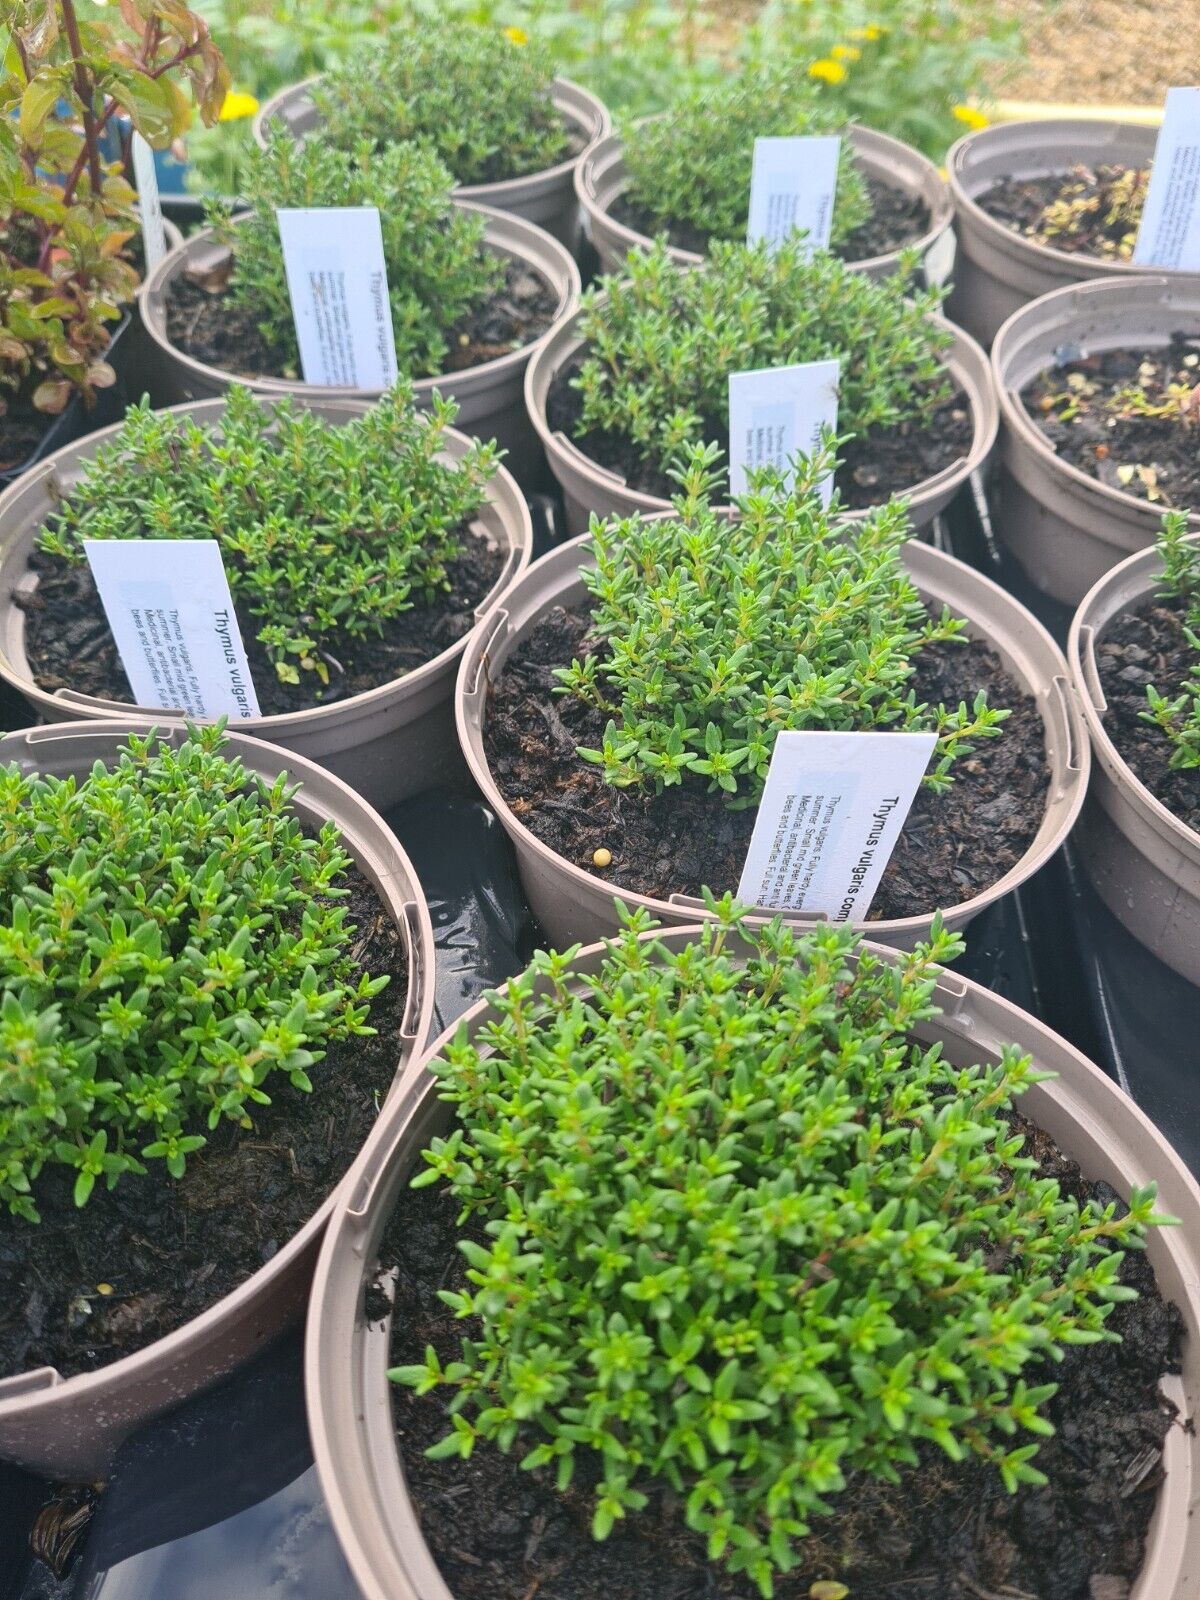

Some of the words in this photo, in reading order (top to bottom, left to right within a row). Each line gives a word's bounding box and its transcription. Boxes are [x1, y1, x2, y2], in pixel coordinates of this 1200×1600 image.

[131, 609, 145, 629] bees
[138, 631, 150, 646] and
[158, 688, 169, 701] Full
[167, 646, 182, 666] Small
[168, 609, 185, 641] Thymus
[188, 676, 200, 693] Fully
[195, 695, 208, 714] hardy
[214, 609, 237, 665] Thymus
[230, 669, 254, 718] vulgaris
[156, 651, 177, 696] antibacterial
[175, 668, 186, 682] mid
[179, 684, 192, 704] green
[783, 795, 798, 813] bees
[822, 796, 842, 824] Thymus
[779, 815, 791, 829] and
[866, 796, 899, 846] Thymus
[800, 829, 816, 847] Small
[780, 833, 799, 872] antibacterial
[797, 849, 808, 861] mid
[764, 867, 777, 878] Full
[789, 863, 803, 881] green
[806, 856, 821, 872] Fully
[848, 850, 875, 894] vulgaris
[775, 875, 787, 887] and
[798, 873, 813, 890] hardy
[771, 889, 783, 899] anti
